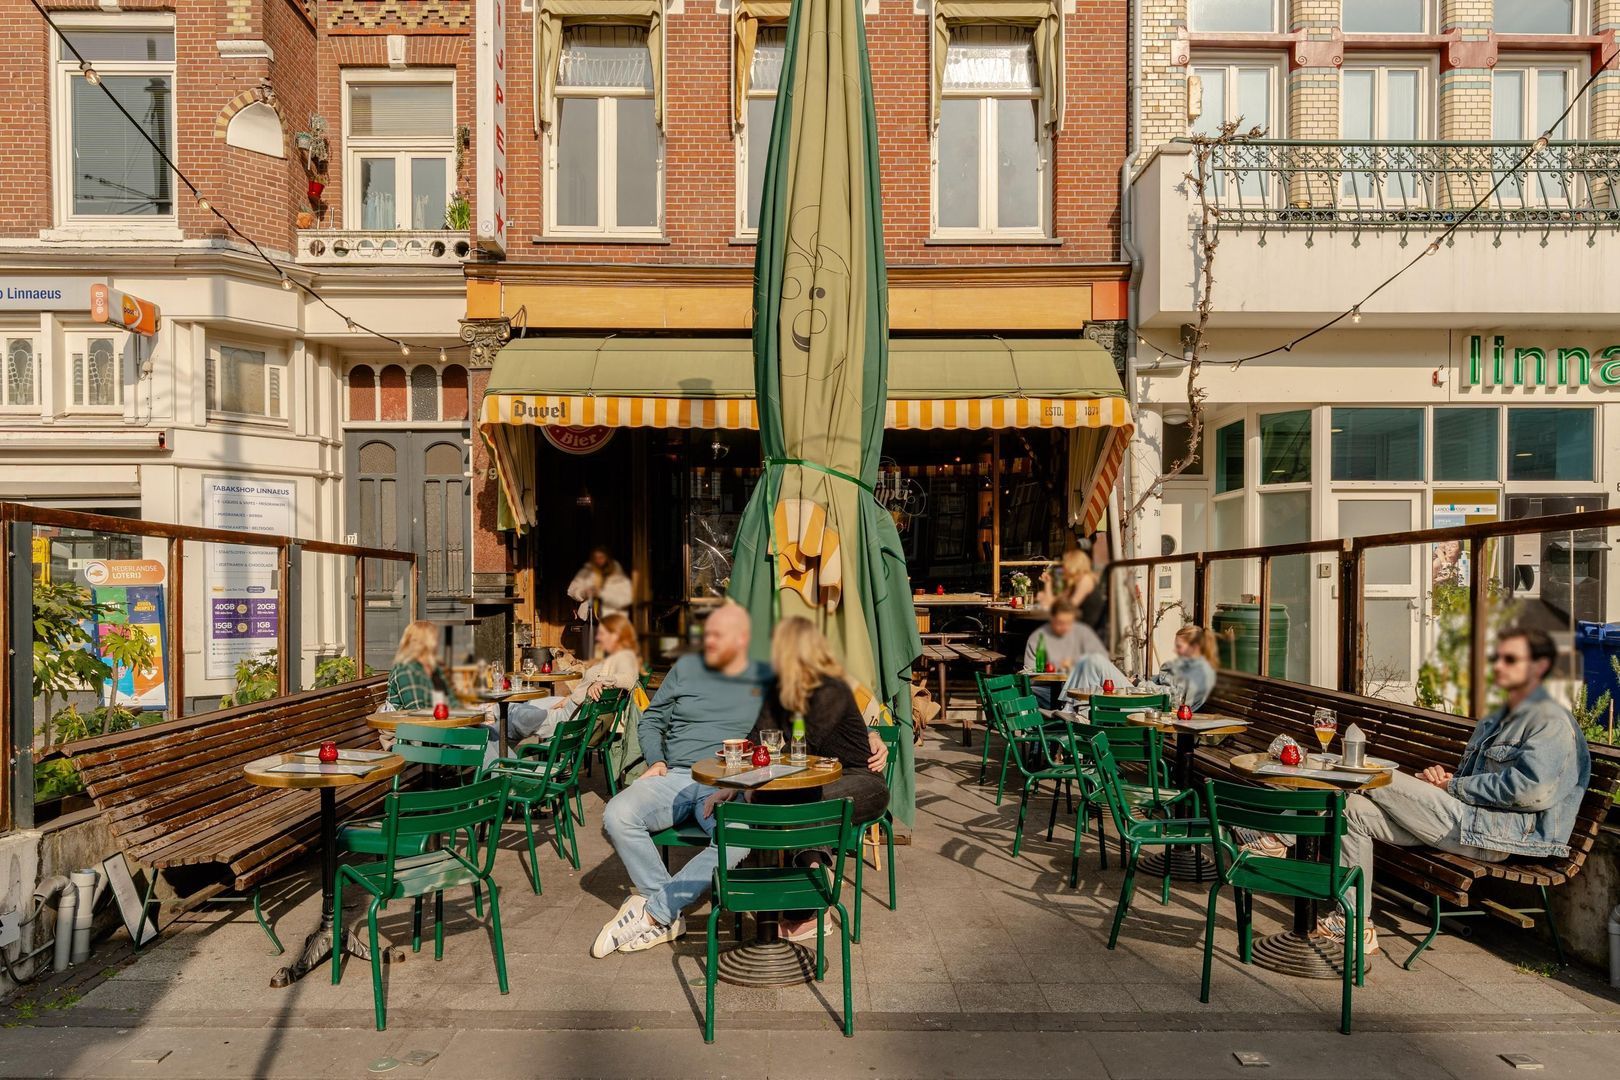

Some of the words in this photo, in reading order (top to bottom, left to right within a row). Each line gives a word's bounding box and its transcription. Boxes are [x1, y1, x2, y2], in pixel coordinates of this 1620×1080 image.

[7, 287, 62, 300] Linnaeus
[513, 399, 566, 419] Duvel
[560, 432, 597, 447] Bier
